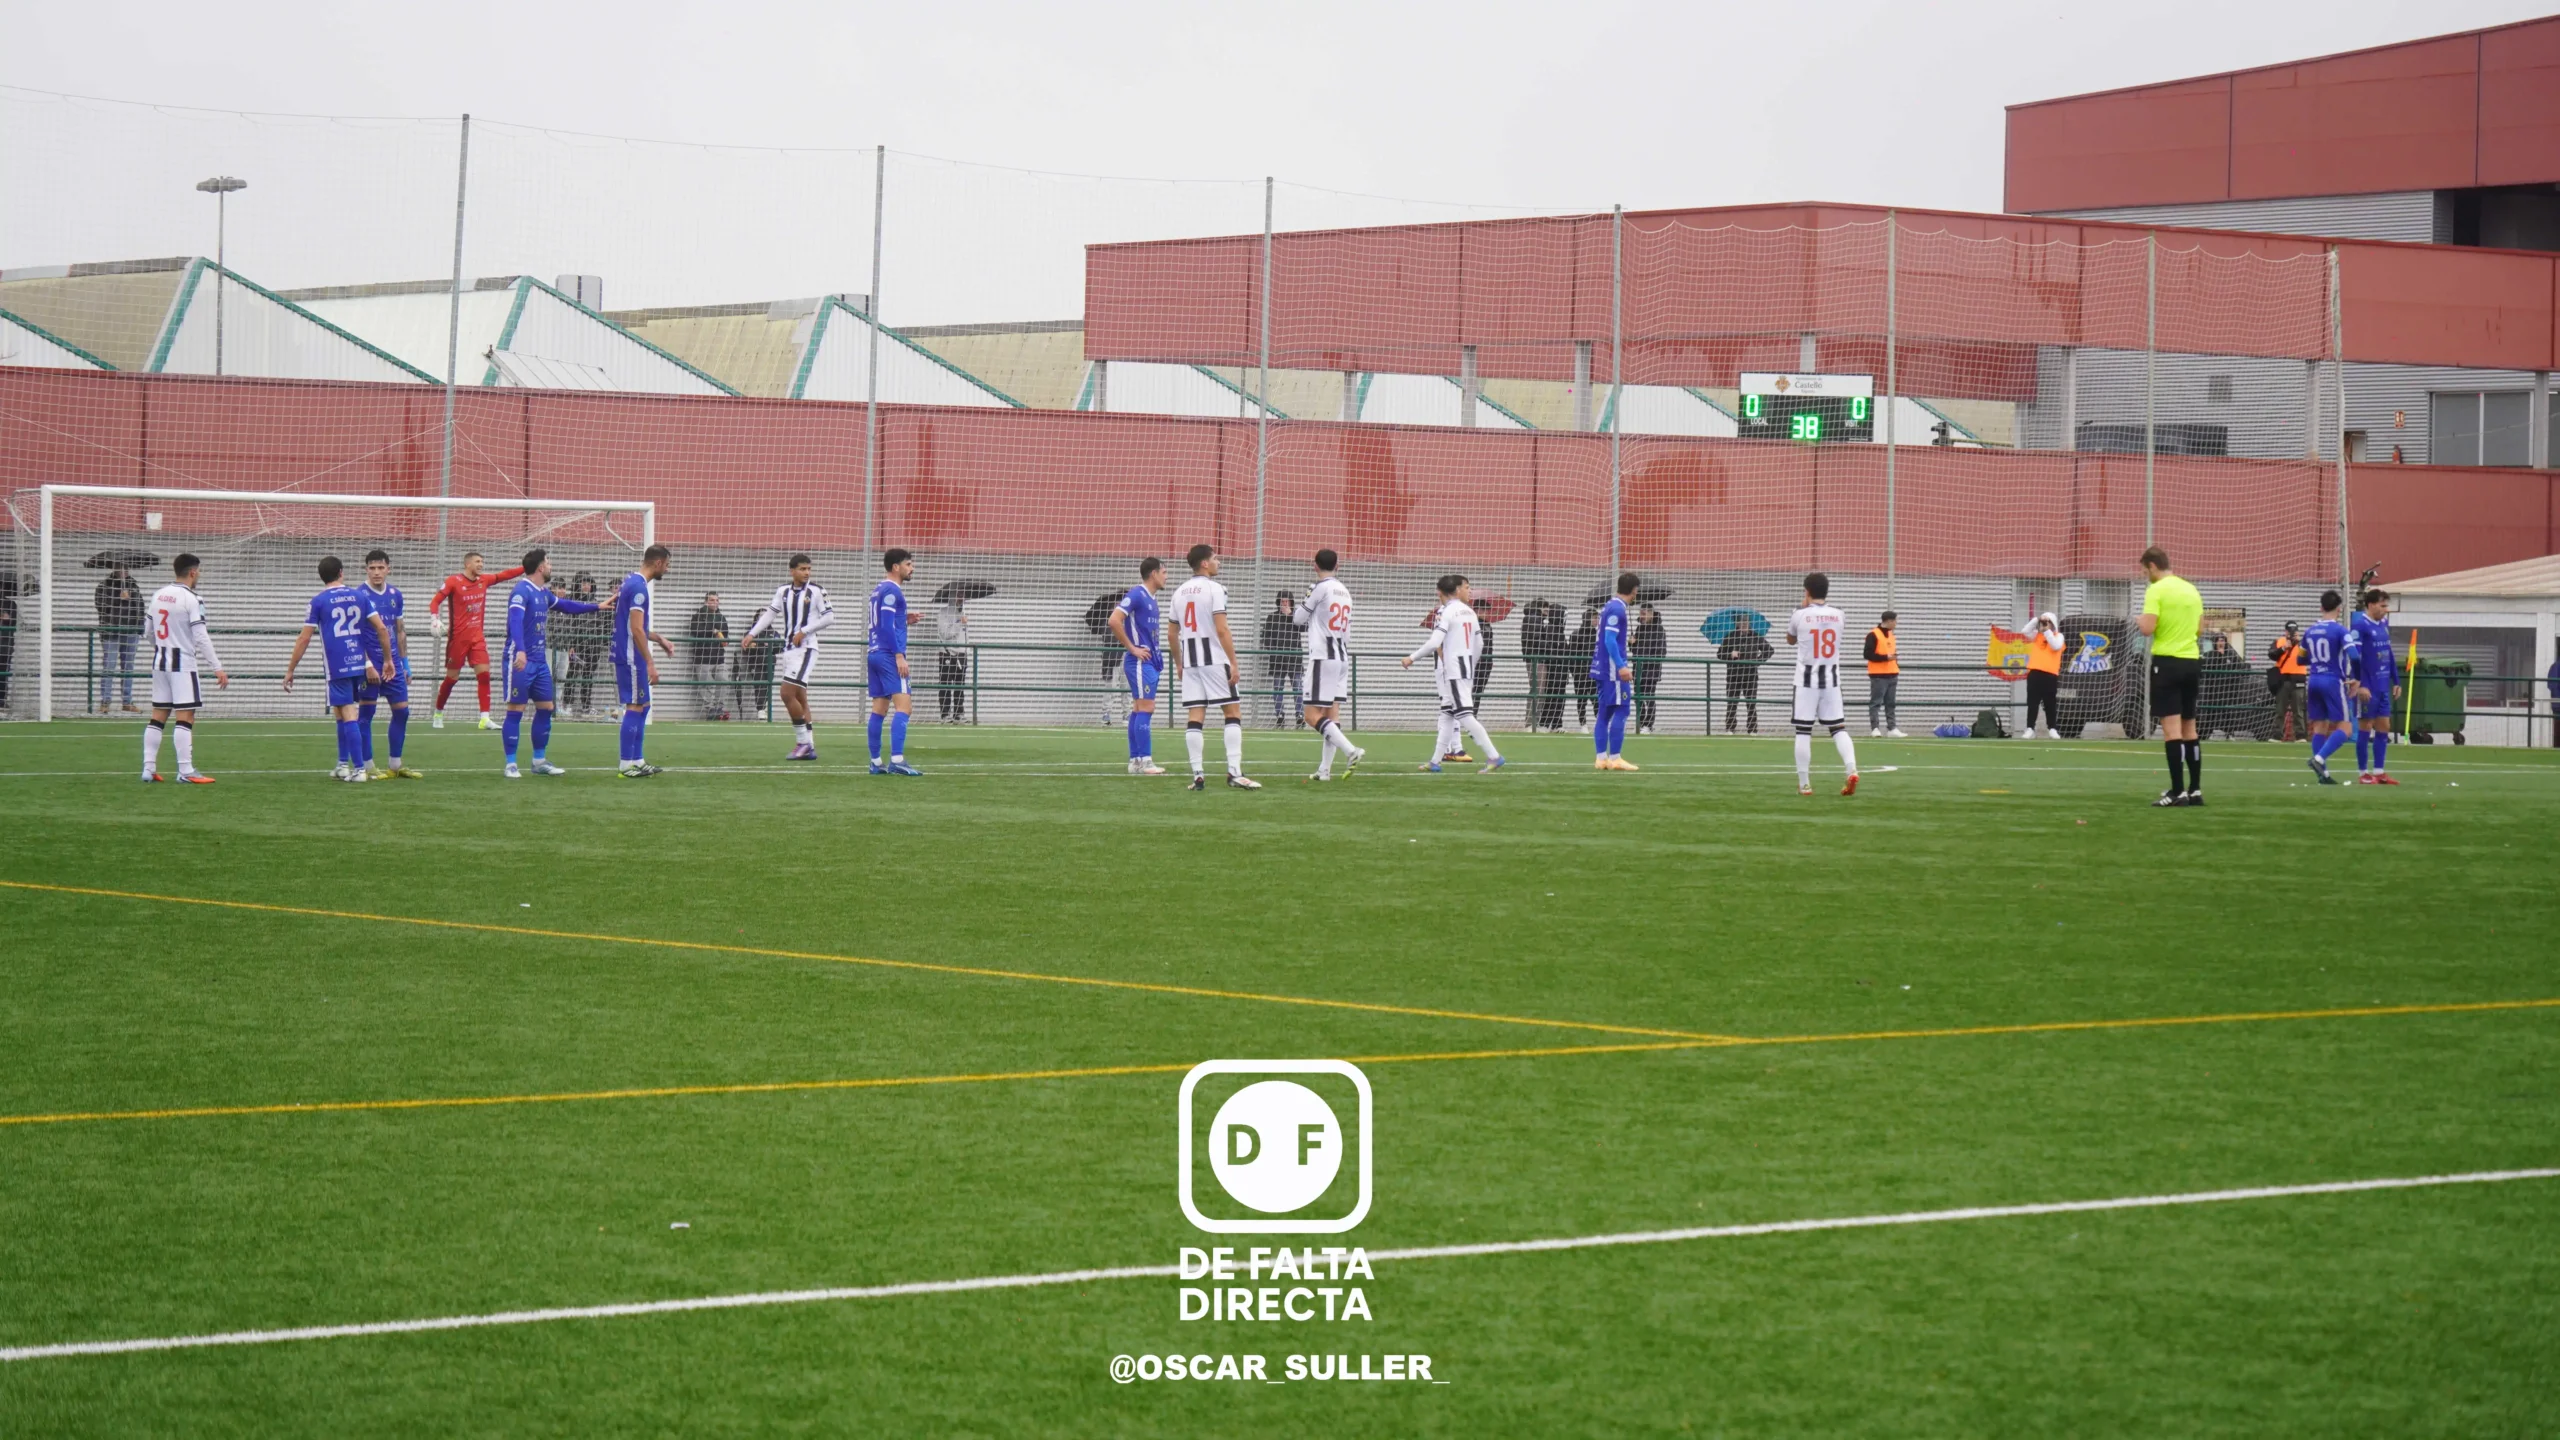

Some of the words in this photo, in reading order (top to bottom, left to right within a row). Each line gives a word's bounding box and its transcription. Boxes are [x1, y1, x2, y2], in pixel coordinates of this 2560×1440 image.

[1746, 394, 1759, 417] 0
[1852, 396, 1866, 420] 0
[1750, 417, 1768, 426] LOCAL
[1792, 415, 1819, 439] 38
[157, 608, 169, 640] 3
[331, 605, 362, 638] 22
[1184, 601, 1198, 632] 4
[1328, 602, 1351, 633] 26
[1809, 628, 1837, 659] 18
[2306, 637, 2331, 664] 10
